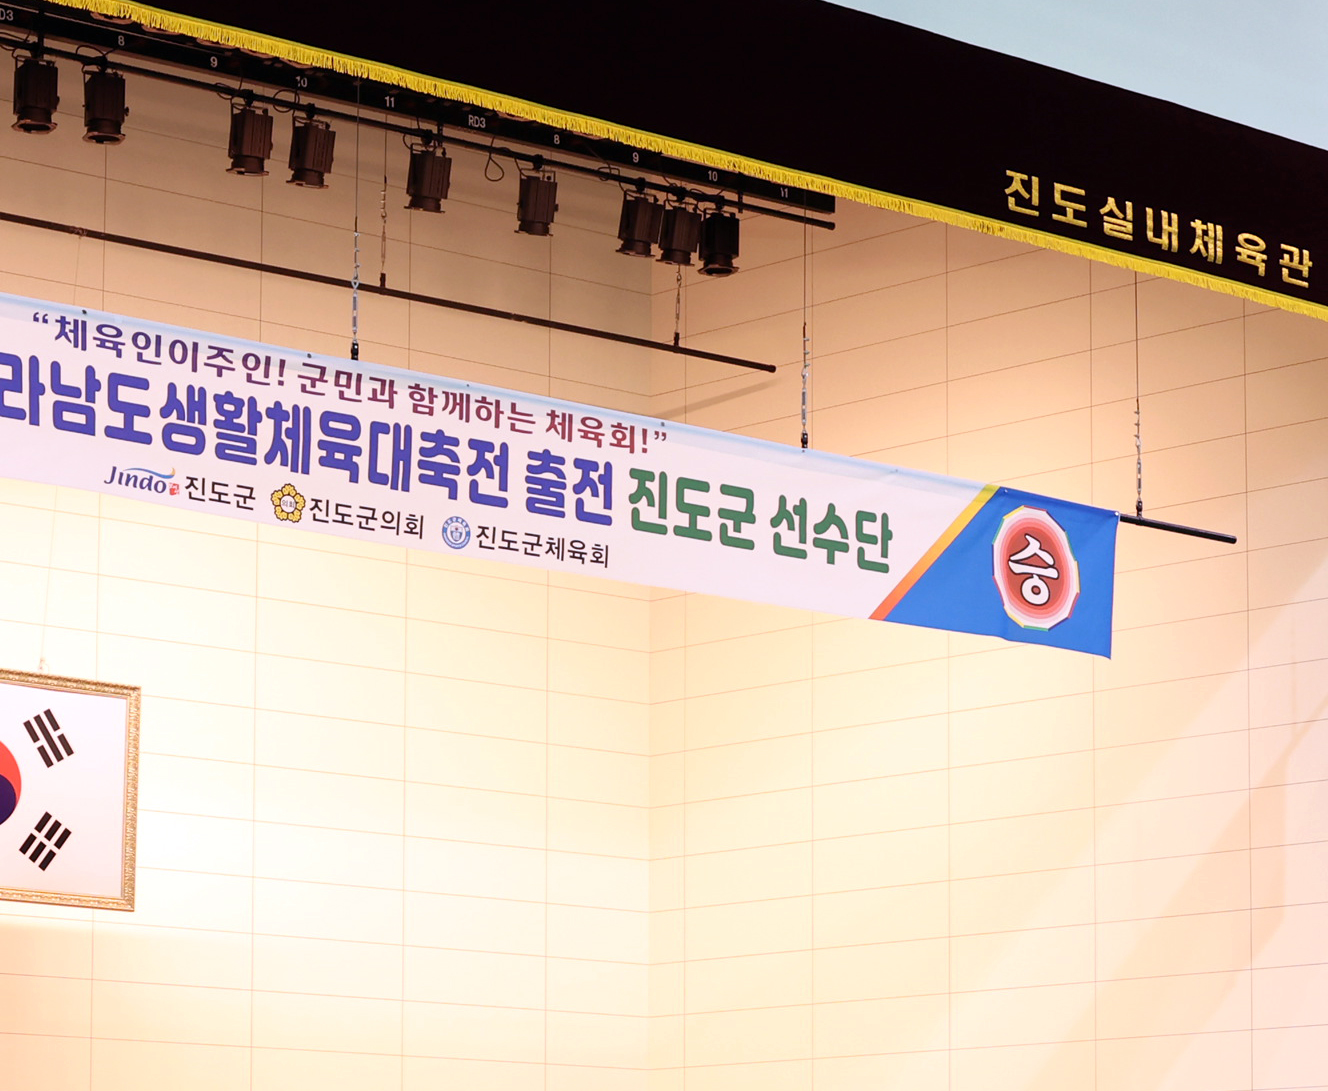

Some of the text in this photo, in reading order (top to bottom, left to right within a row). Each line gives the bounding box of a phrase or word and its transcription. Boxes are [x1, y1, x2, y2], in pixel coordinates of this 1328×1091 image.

[117, 35, 125, 47] 8
[210, 56, 218, 68] 9
[468, 115, 486, 129] RD3
[553, 134, 560, 145] 8
[632, 152, 639, 164] 9
[1004, 169, 1313, 289] 진도실내체육관
[297, 361, 398, 409] 군민과
[407, 383, 536, 434] 함께하는
[104, 466, 167, 494] Jindo
[185, 476, 256, 511] 진도군
[309, 498, 424, 540] 진도군의회
[476, 525, 609, 568] 진도군체육회
[525, 448, 613, 526] 출전
[628, 467, 756, 551] 진도군
[770, 494, 893, 574] 선수단
[1008, 533, 1060, 606] 승
